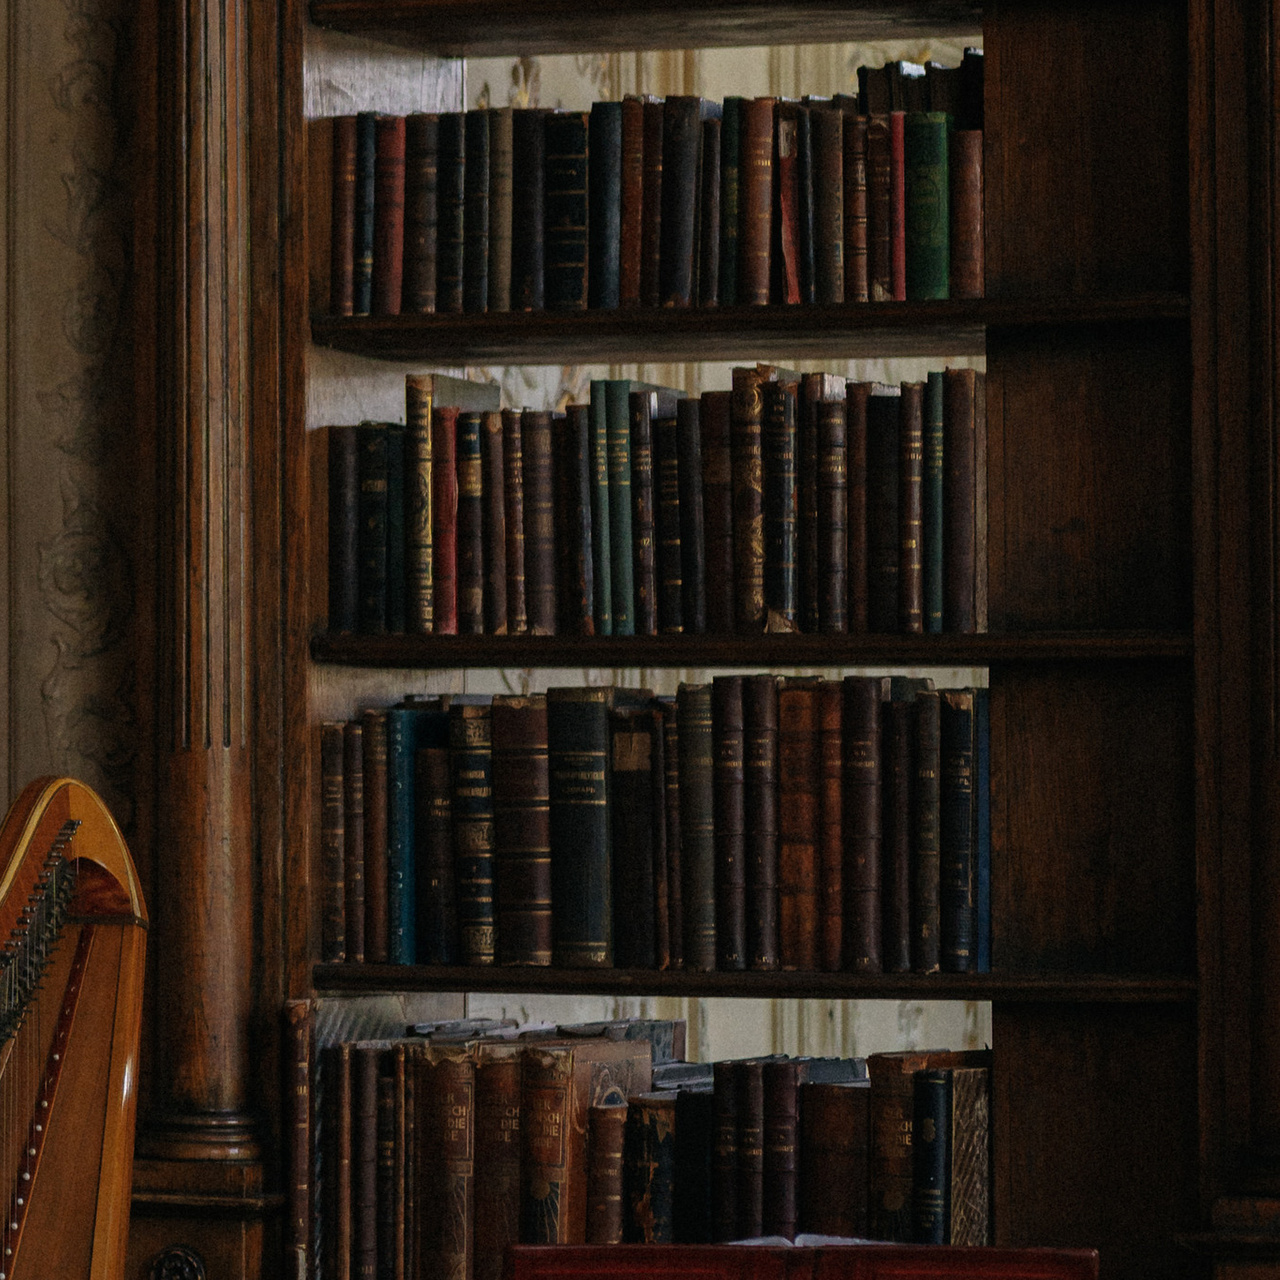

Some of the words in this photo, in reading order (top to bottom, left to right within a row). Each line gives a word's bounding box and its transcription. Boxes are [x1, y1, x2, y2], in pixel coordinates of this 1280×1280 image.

[447, 1117, 467, 1129] DIE
[500, 1119, 520, 1130] DIE
[542, 1124, 560, 1137] DIE
